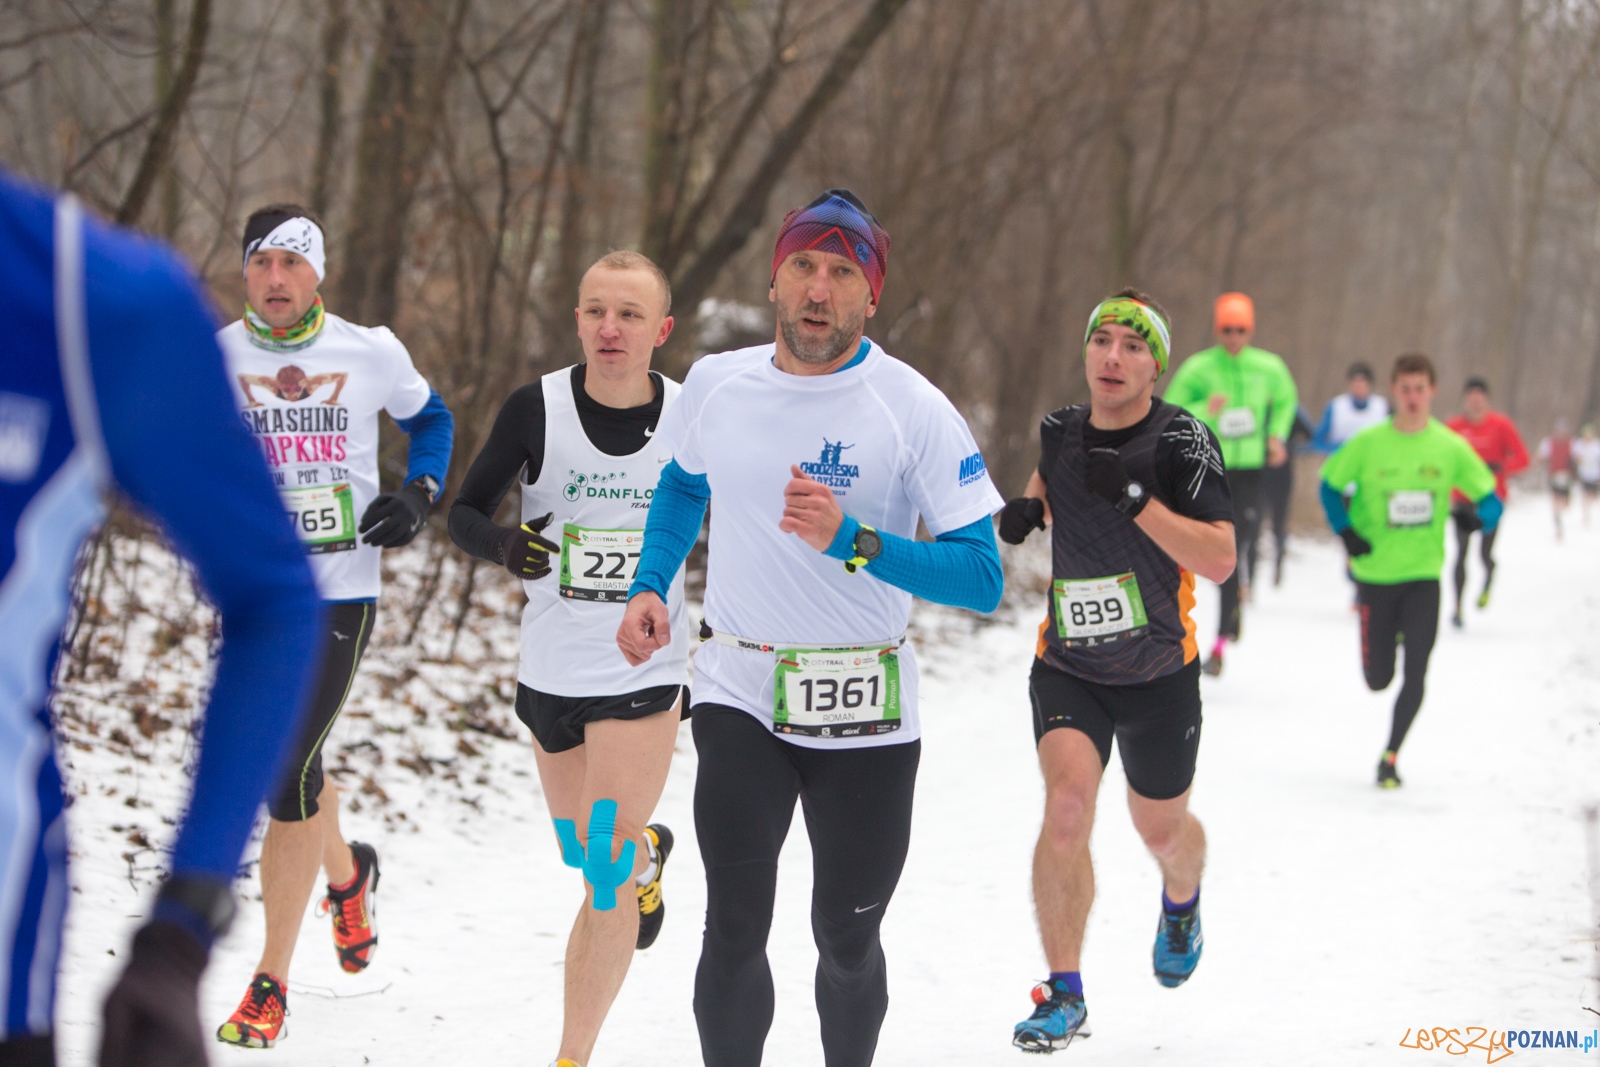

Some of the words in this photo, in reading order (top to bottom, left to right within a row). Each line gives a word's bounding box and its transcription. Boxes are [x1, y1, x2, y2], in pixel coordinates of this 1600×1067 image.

[241, 407, 348, 433] SMASHING
[297, 469, 319, 485] POT
[286, 507, 336, 532] 765
[583, 551, 641, 580] 227
[1070, 597, 1124, 626] 839
[737, 640, 775, 653] TRIATHLON
[799, 674, 879, 712] 1361
[823, 712, 855, 723] ROMAN
